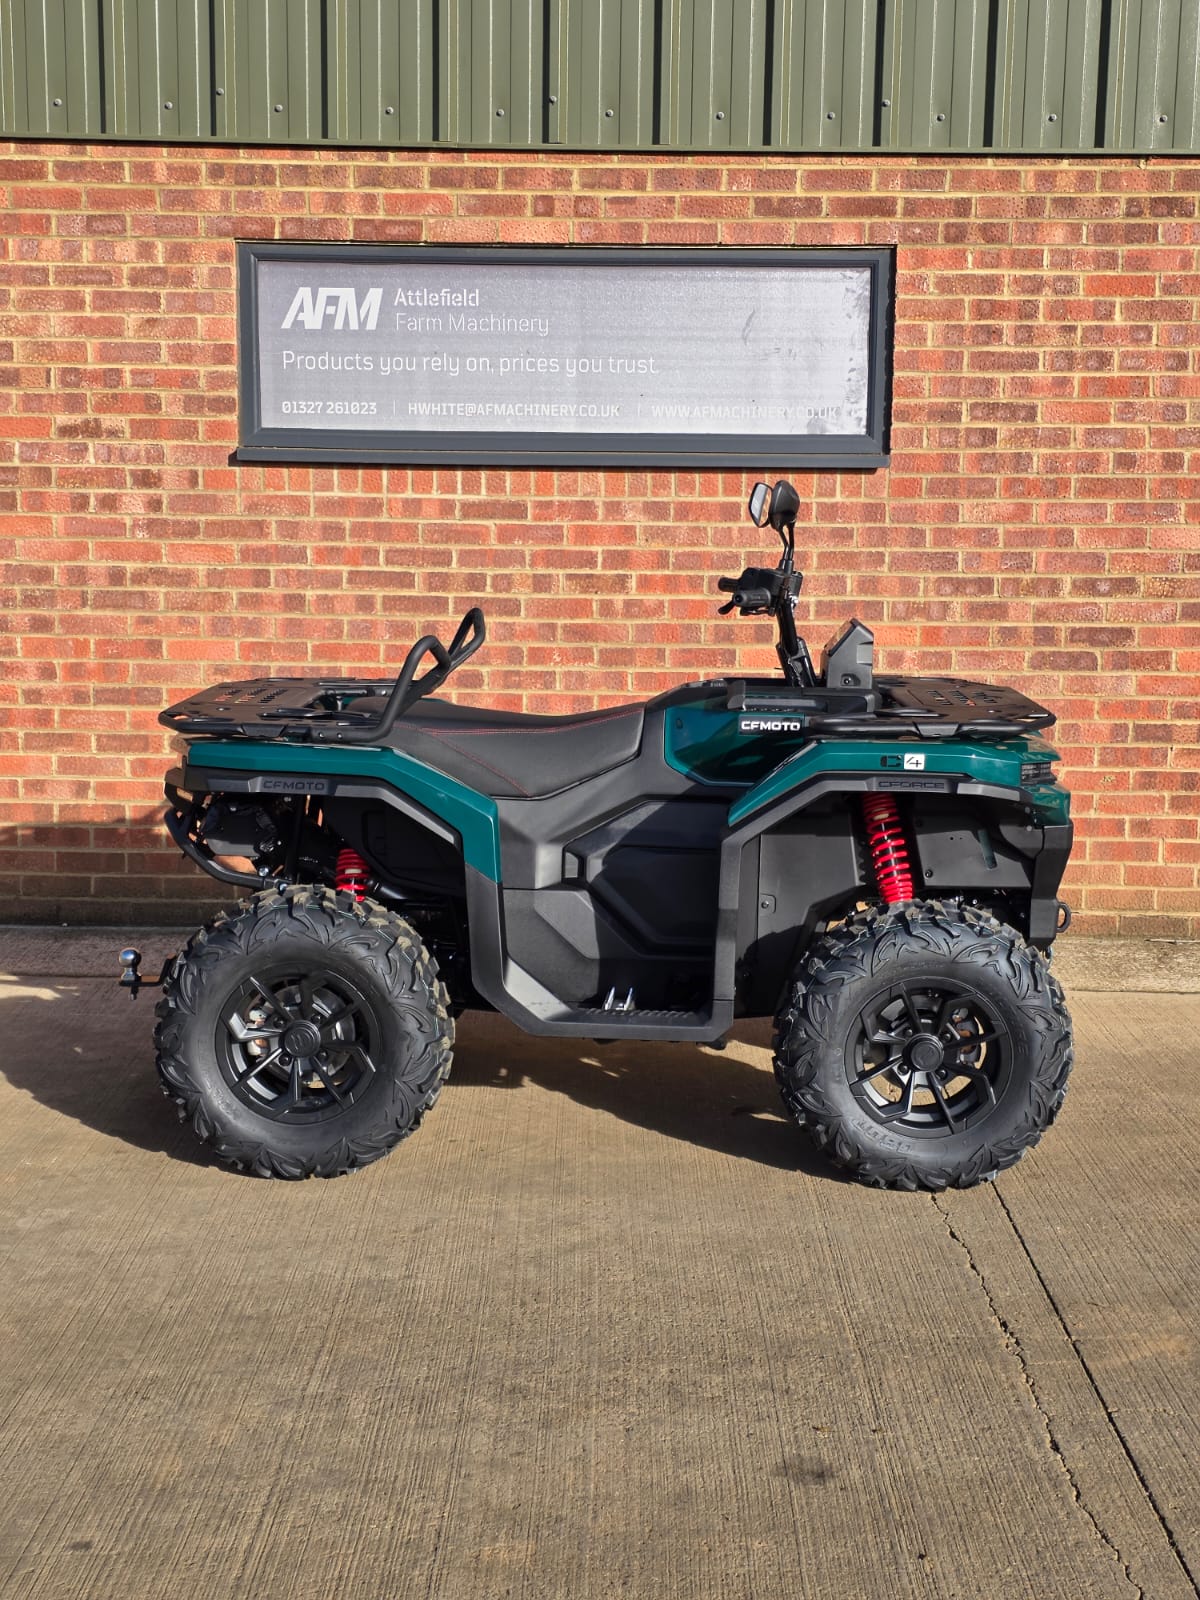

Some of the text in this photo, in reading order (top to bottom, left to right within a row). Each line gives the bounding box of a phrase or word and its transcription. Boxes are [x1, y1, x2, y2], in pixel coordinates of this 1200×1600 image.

[394, 288, 480, 307] Attlefield
[281, 287, 384, 330] AFM
[395, 313, 550, 337] Farm Machinery
[282, 351, 374, 371] Products
[380, 356, 416, 376] you
[423, 353, 460, 376] rely
[466, 357, 495, 375] on,
[500, 355, 560, 377] prices
[566, 358, 602, 378] you
[281, 401, 837, 419] 01327 261023 HWHITE@AFMACHINERY.CO.UK WWW.AFMACHINERY.CO.UK
[741, 720, 801, 732] CFMOTO
[263, 780, 325, 791] CFMOTO
